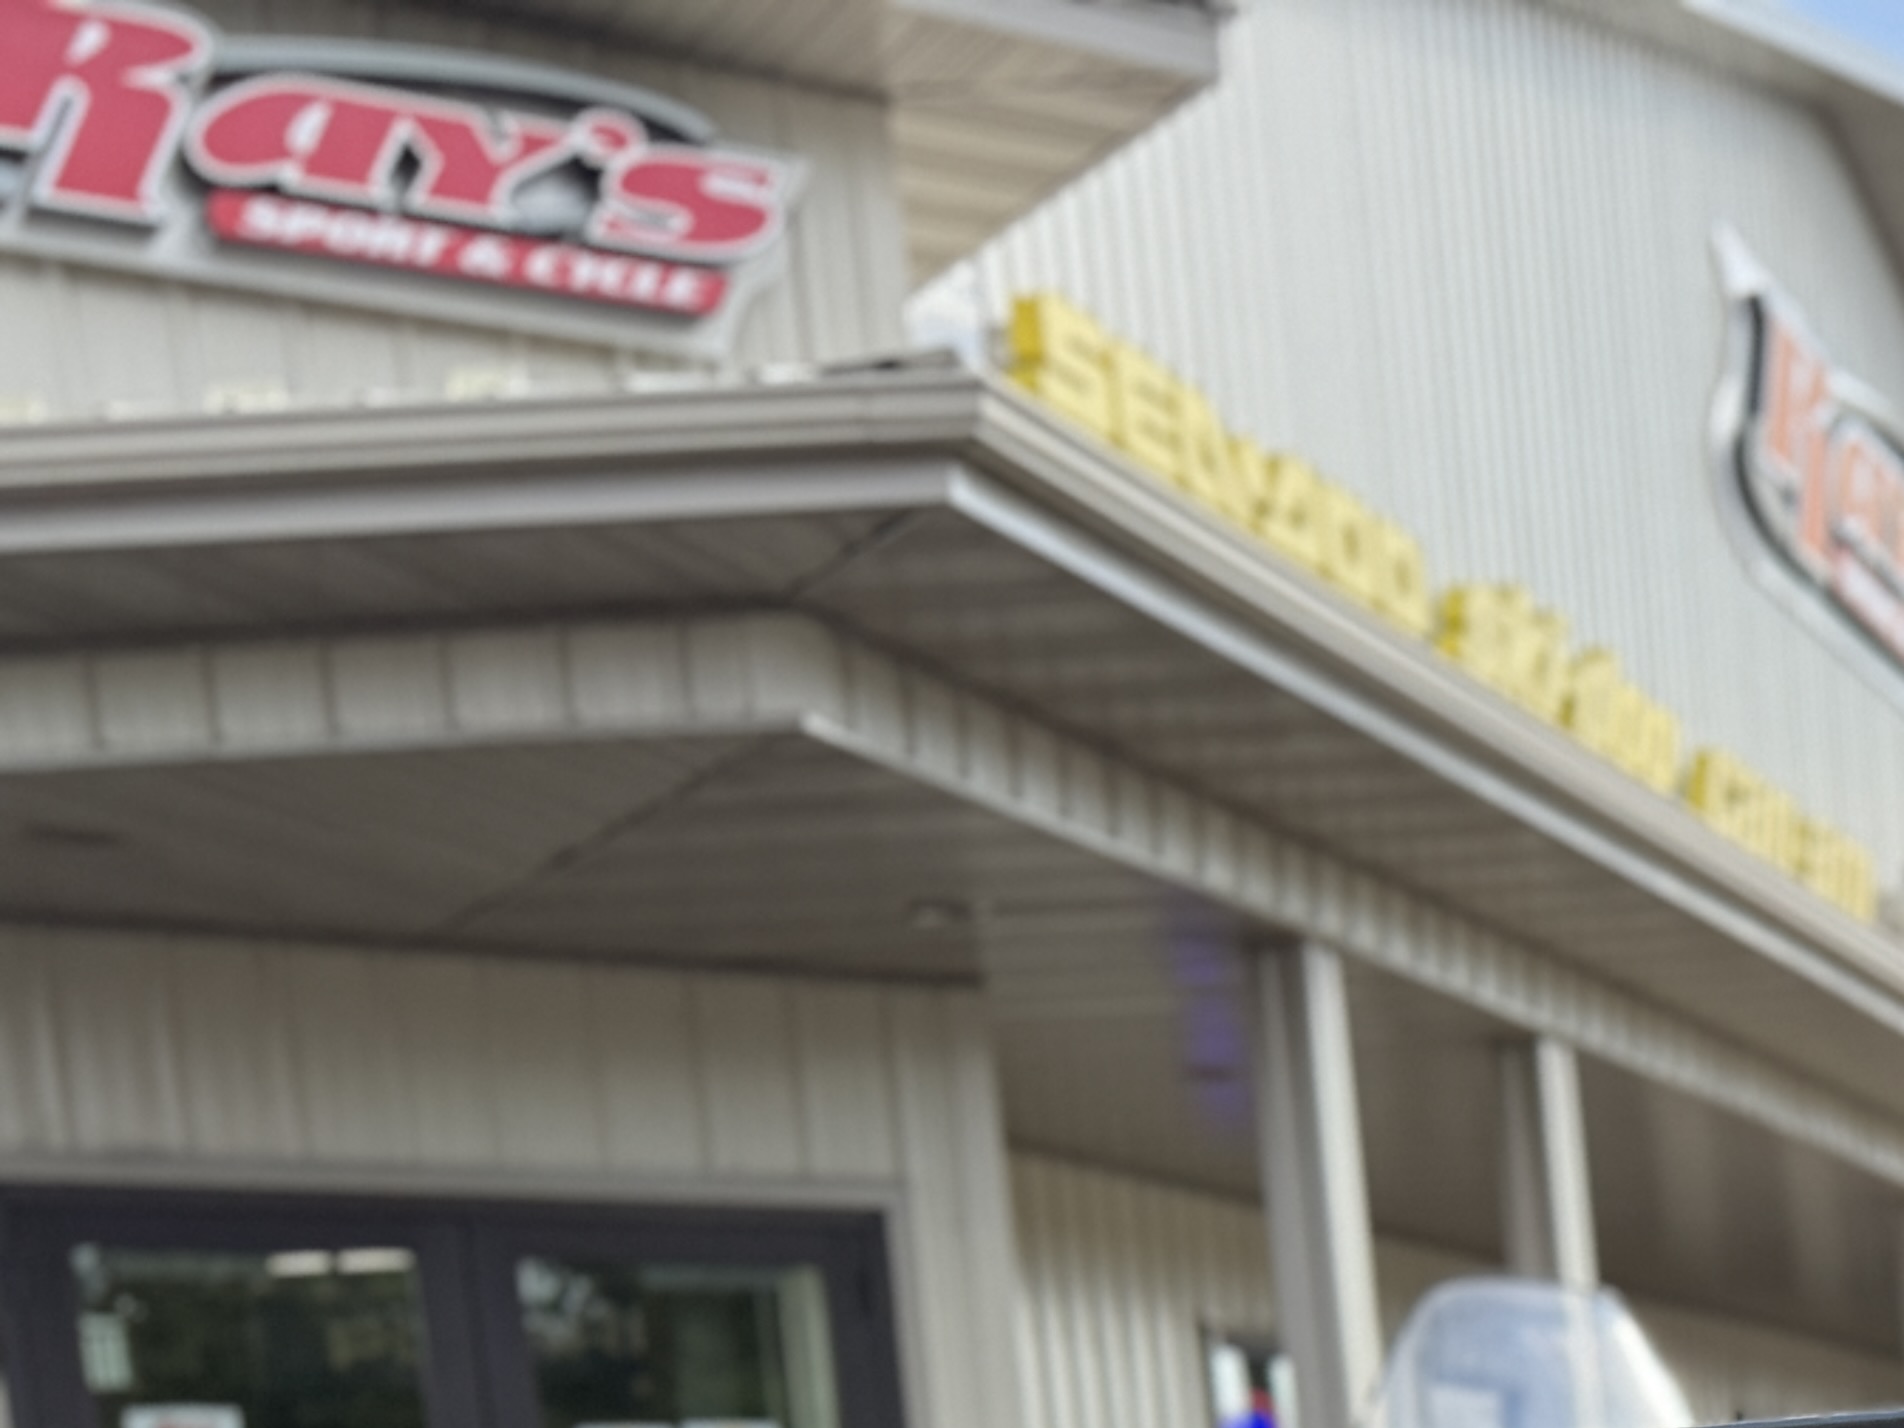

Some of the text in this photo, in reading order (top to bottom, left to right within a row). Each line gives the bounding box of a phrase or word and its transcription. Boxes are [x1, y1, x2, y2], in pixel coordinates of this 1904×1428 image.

[0, 0, 785, 262] Ray's
[236, 198, 708, 309] SPORT & CYCLE
